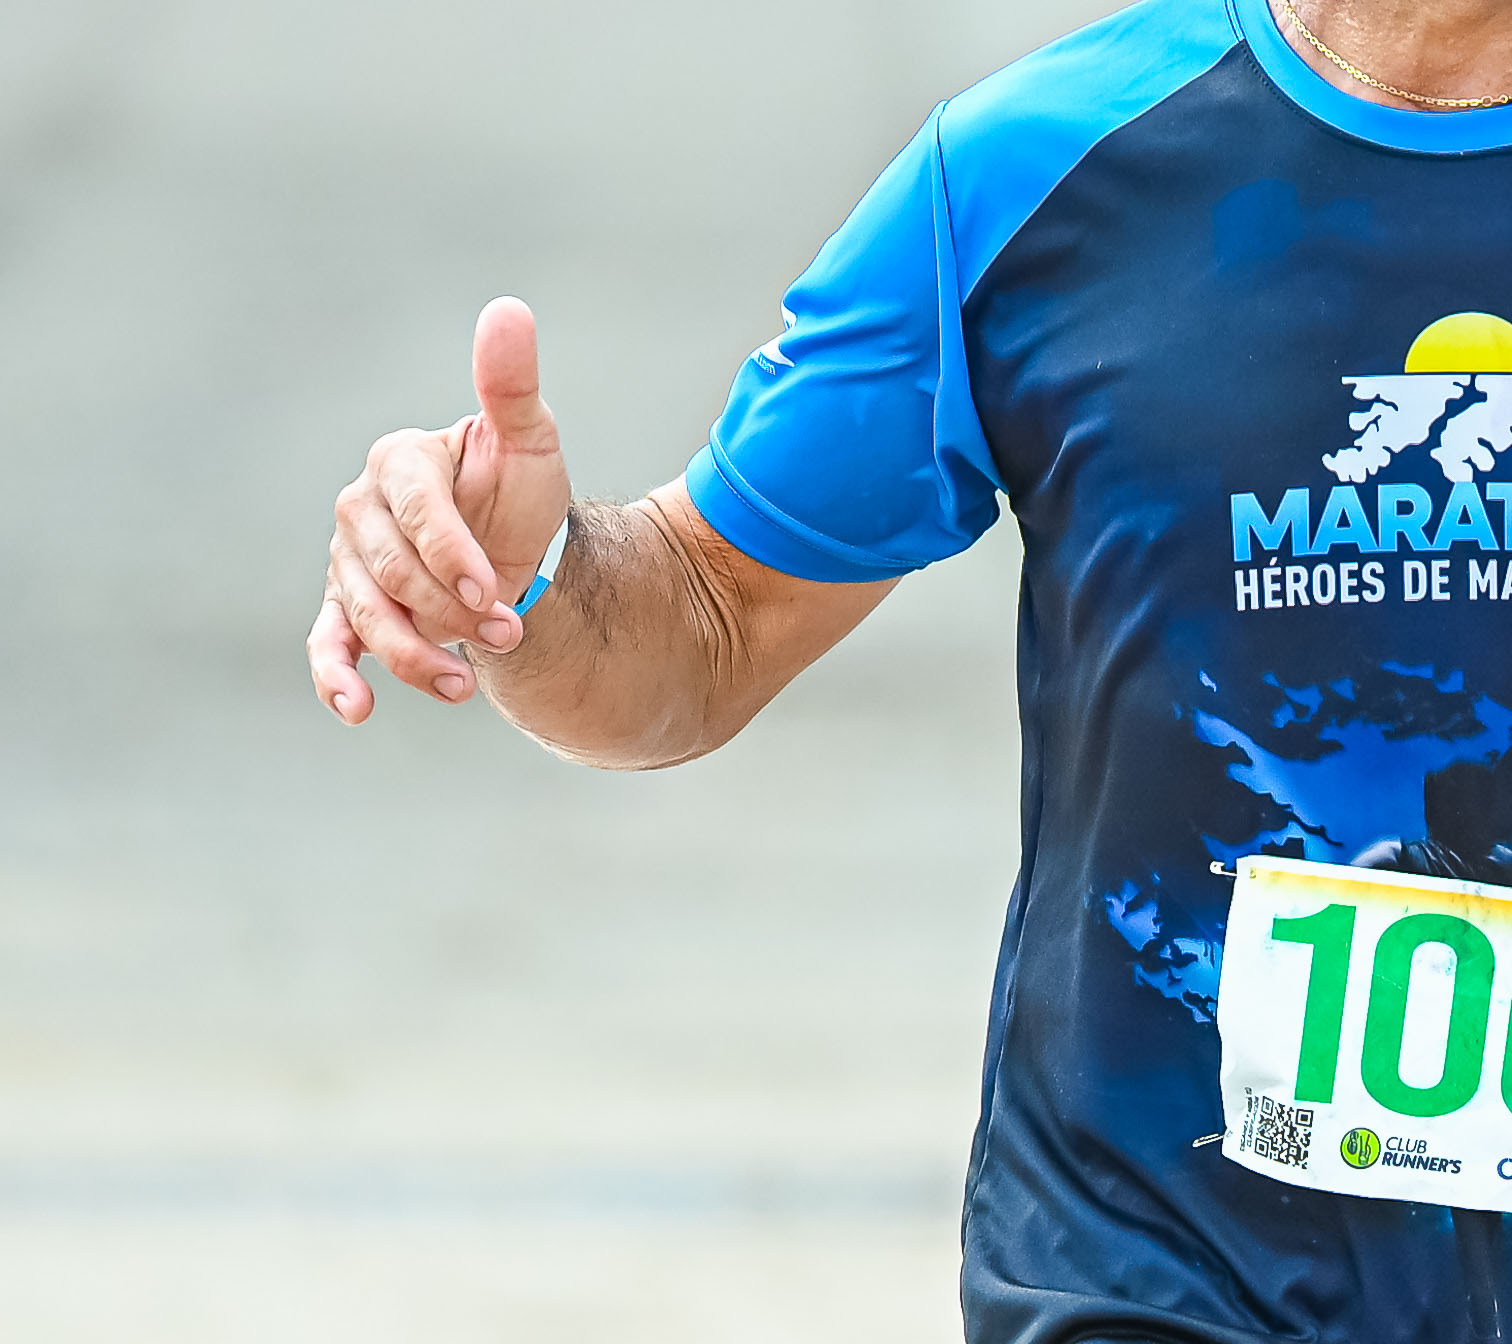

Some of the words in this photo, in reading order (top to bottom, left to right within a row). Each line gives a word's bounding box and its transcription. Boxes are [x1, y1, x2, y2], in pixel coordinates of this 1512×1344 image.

[1234, 556, 1386, 611] HÉROES
[1403, 559, 1451, 601] DE
[1386, 1136, 1428, 1154] CLUB
[1382, 1151, 1462, 1174] RUNNER'S
